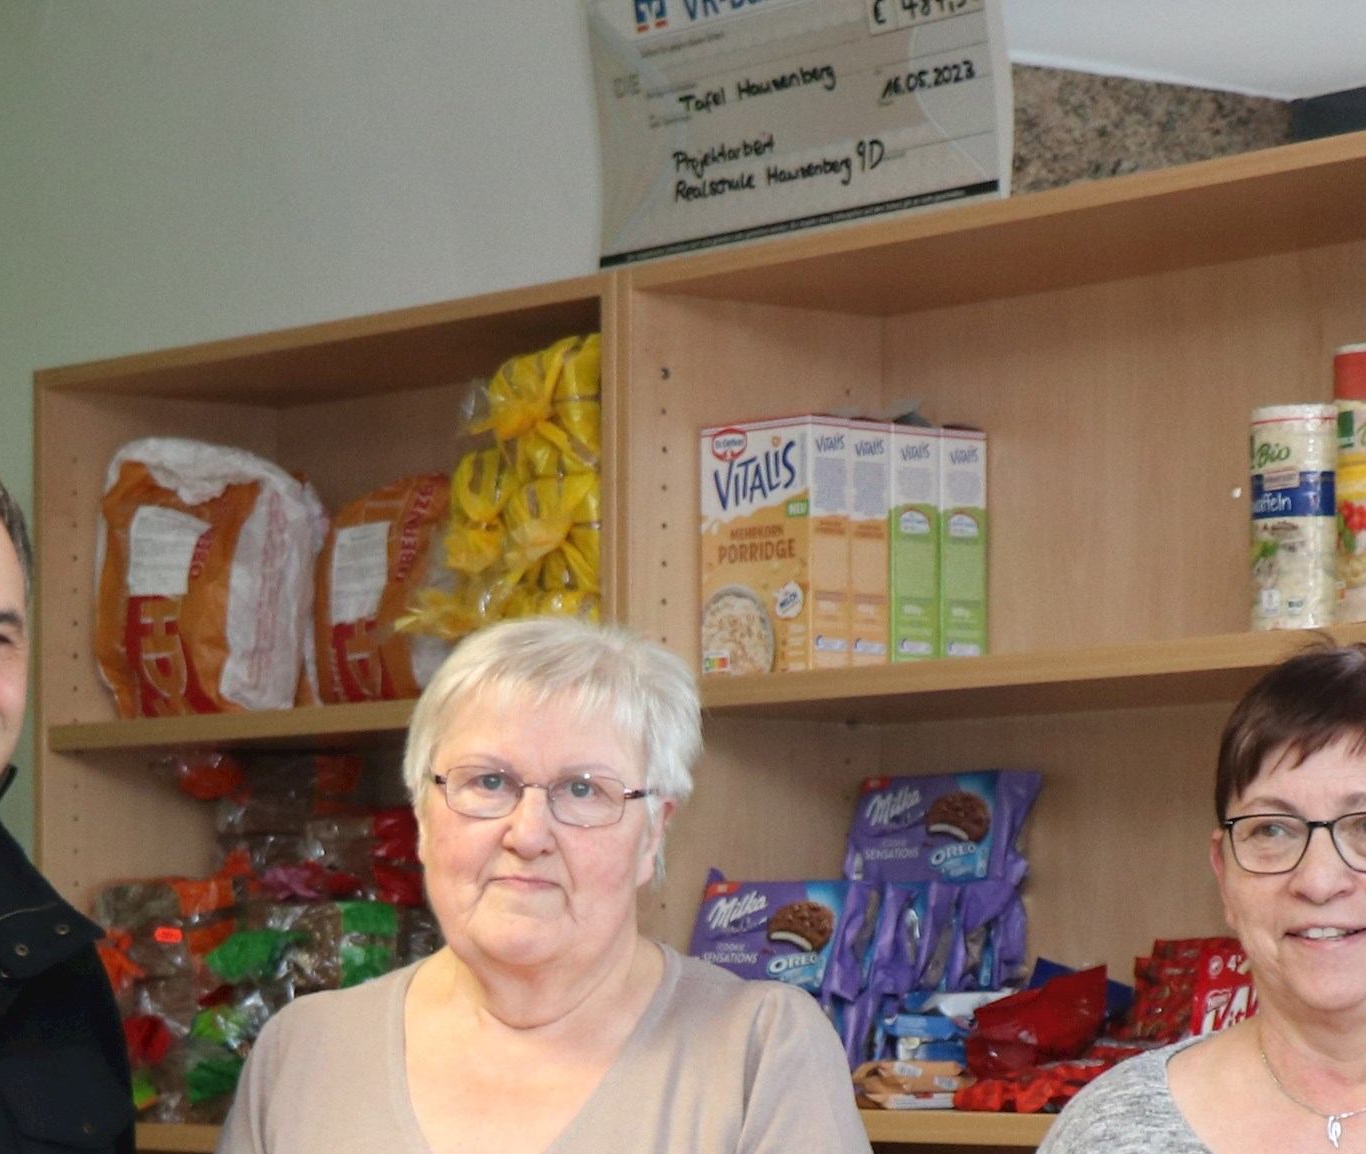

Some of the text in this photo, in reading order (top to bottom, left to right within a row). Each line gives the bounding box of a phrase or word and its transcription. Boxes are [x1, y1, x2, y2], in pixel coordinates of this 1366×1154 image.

[678, 87, 726, 113] Tafel
[1256, 442, 1291, 469] Bio
[788, 501, 808, 516] NEU
[718, 538, 797, 566] PORRIDGE
[866, 785, 922, 827] Milka
[864, 847, 920, 861] SENSATIONS
[930, 842, 977, 866] OREO
[707, 890, 769, 930] Milka
[703, 952, 759, 966] SENSATIONS
[768, 953, 818, 975] OREO
